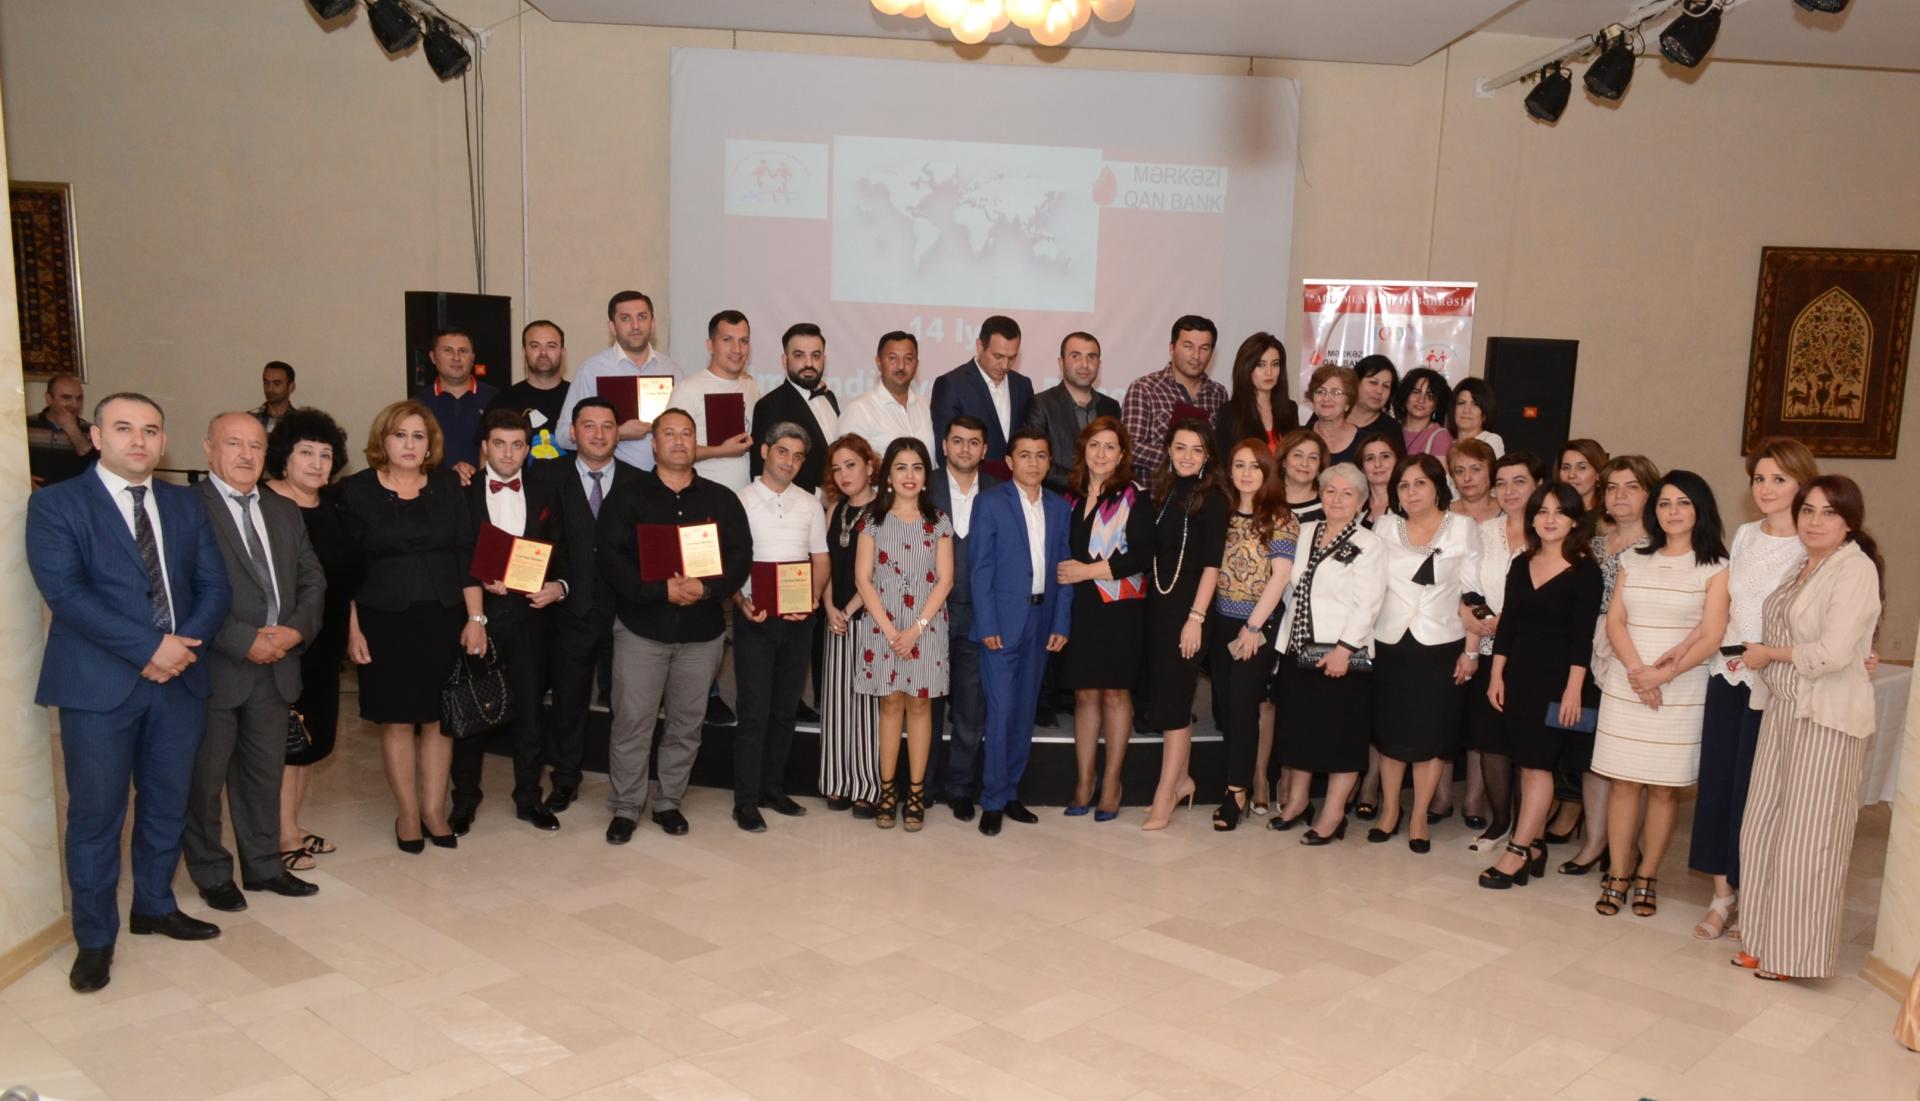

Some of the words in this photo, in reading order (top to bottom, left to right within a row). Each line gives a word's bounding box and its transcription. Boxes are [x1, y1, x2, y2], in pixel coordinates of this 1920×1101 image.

[1124, 190, 1165, 209] QAN
[1171, 192, 1222, 211] BANK
[909, 315, 944, 342] 14
